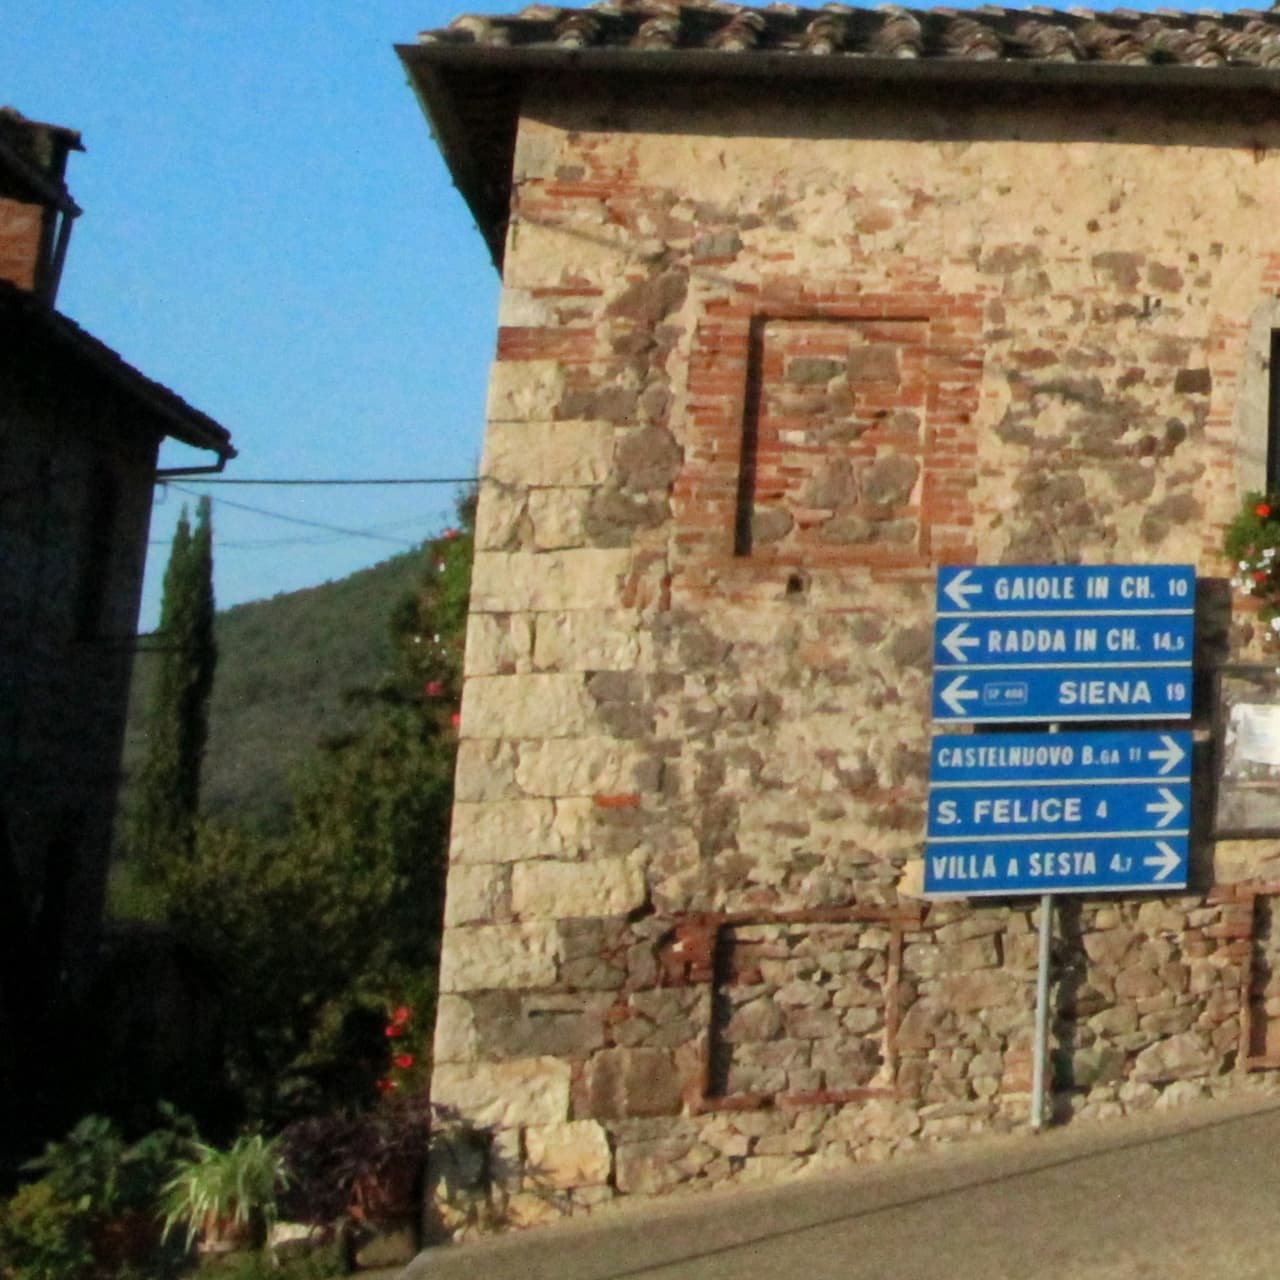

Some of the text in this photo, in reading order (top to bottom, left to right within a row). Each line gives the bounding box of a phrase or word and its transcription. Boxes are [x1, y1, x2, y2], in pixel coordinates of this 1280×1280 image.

[995, 576, 1188, 600] GAIOLE IN CH. 10
[988, 629, 1065, 652] RADDA
[1074, 629, 1097, 652] IN
[1106, 628, 1141, 651] CH.
[1058, 680, 1186, 704] SIENA 19
[937, 745, 1074, 768] CASTELNUOVO
[936, 798, 1108, 825] S. FELICE 4
[932, 854, 997, 880] VILLA
[1006, 859, 1020, 877] A
[1028, 851, 1097, 877] SESTA
